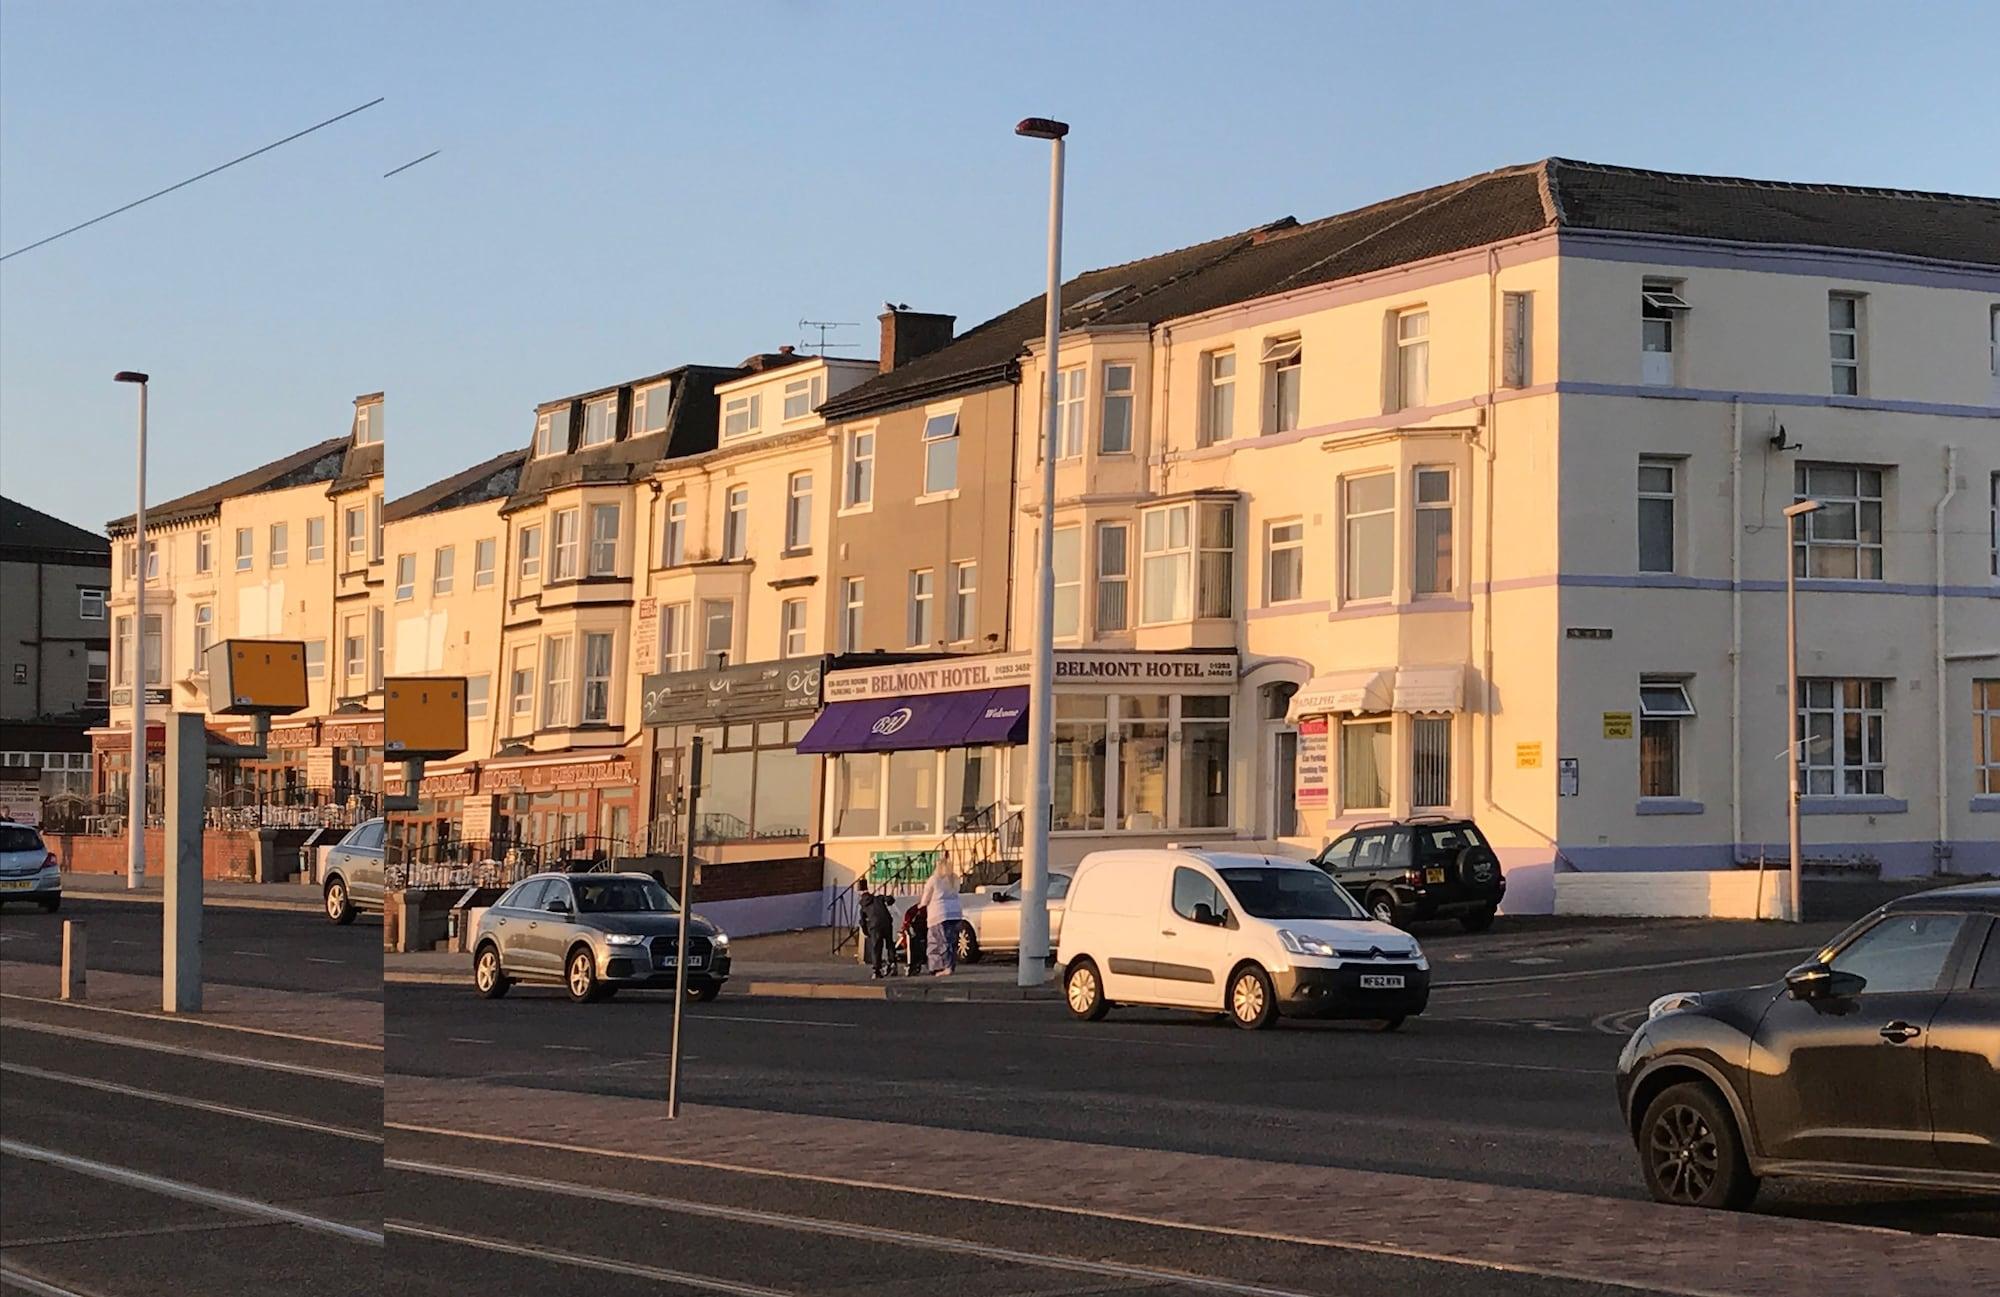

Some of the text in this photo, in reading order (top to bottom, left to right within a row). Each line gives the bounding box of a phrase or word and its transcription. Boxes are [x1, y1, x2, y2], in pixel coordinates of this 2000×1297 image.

[871, 666, 990, 693] BELMONT HOTEL
[1056, 661, 1204, 677] BELMONT HOTEL
[484, 769, 521, 788] HOTEL
[550, 761, 633, 784] RESTAURANT
